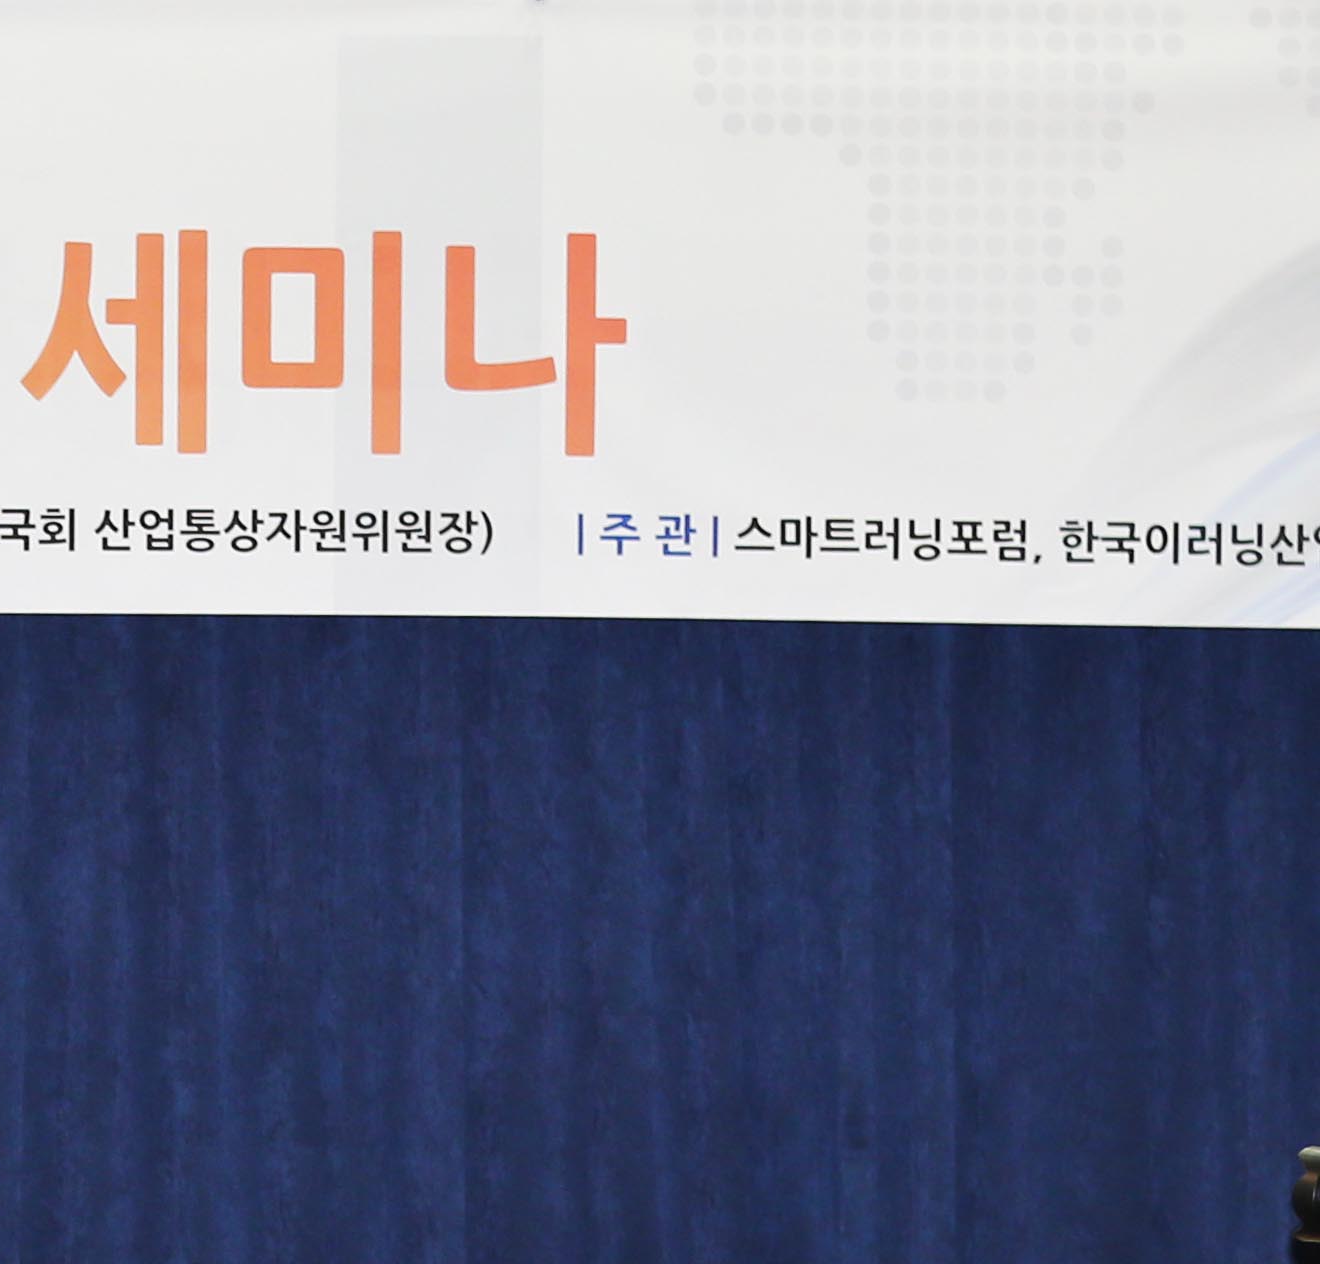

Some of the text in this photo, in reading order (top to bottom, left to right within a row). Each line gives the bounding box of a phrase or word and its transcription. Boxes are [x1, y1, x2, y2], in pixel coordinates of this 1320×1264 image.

[21, 230, 627, 456] 세미나
[94, 508, 493, 556] 산업통상자원위원장)
[734, 515, 1042, 565] 스마트러닝포럼,
